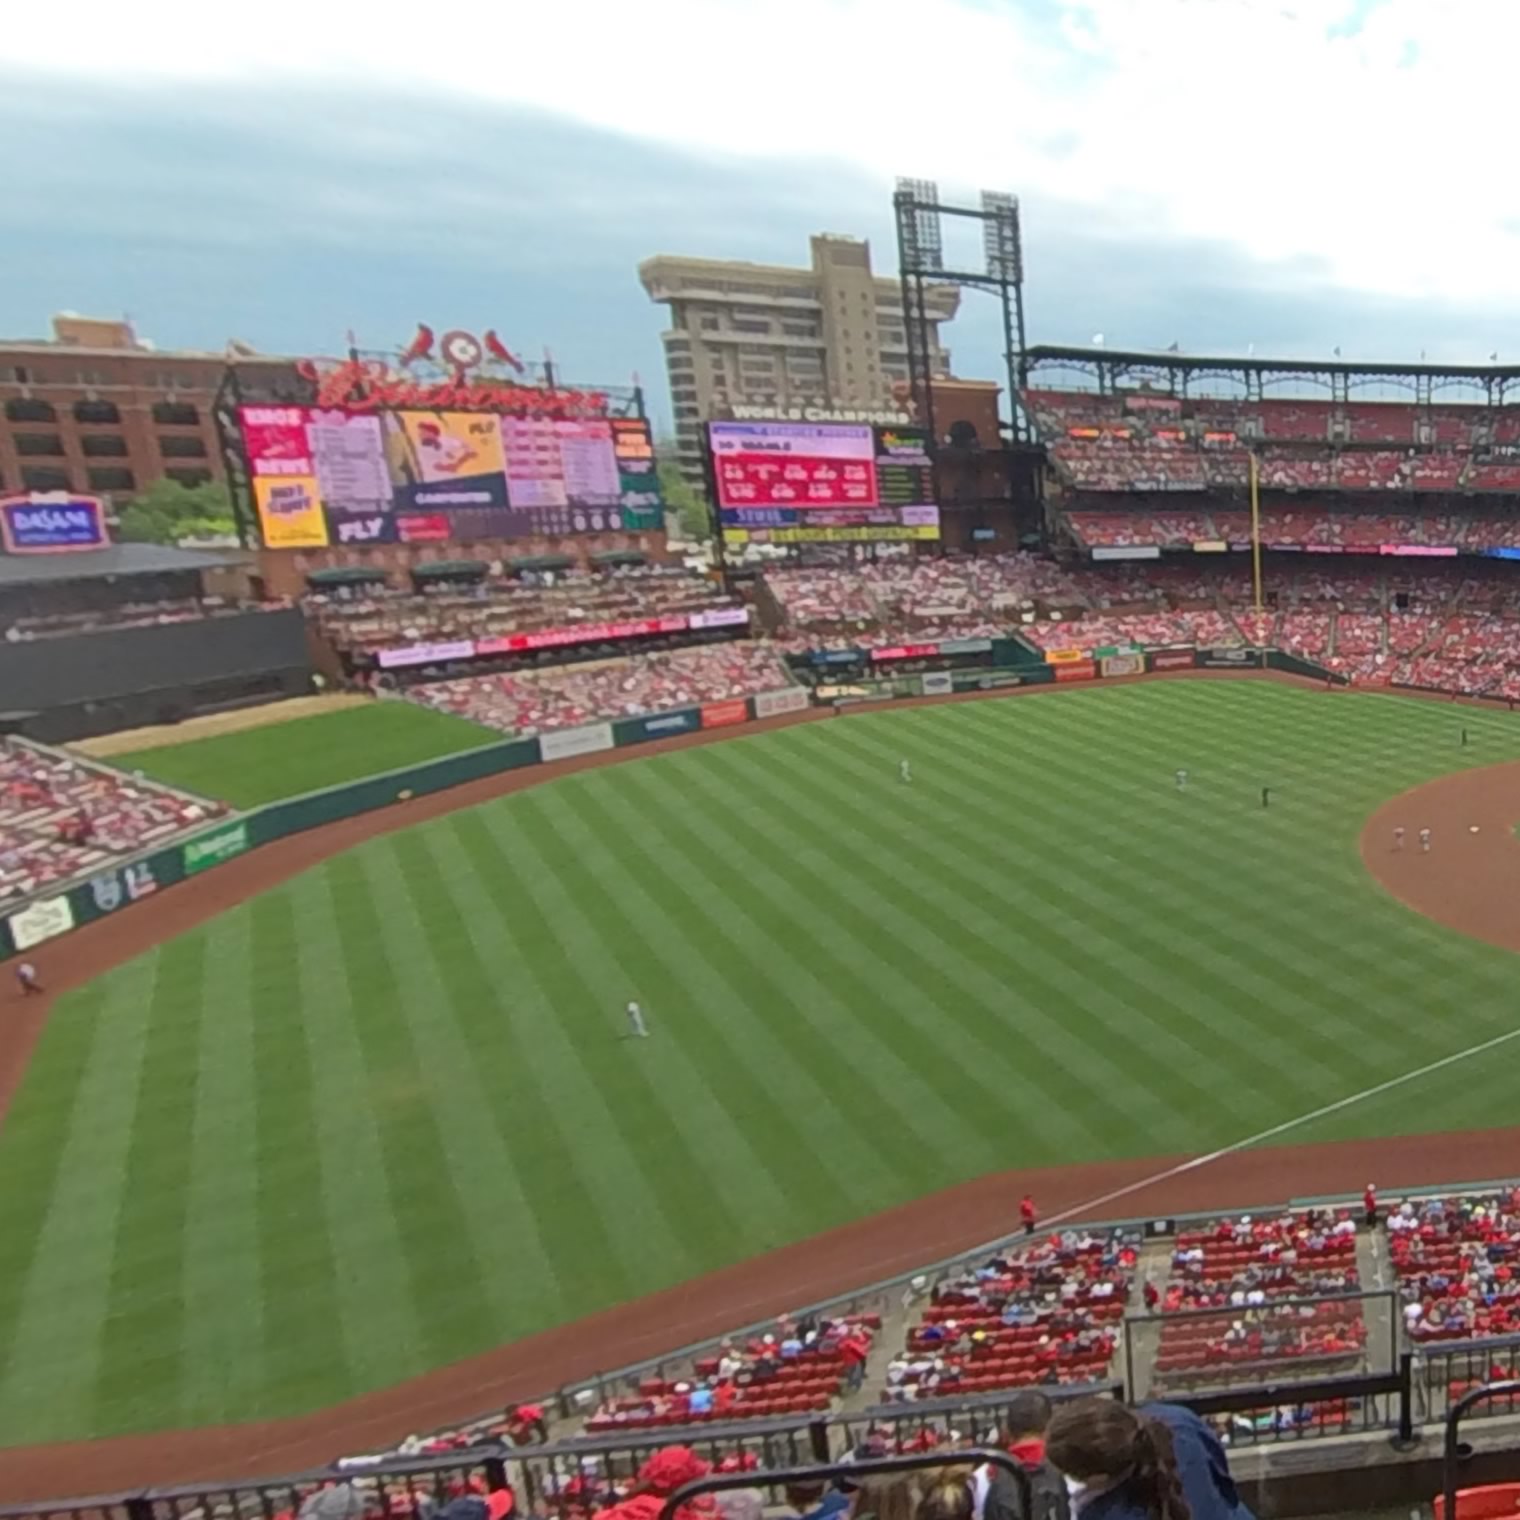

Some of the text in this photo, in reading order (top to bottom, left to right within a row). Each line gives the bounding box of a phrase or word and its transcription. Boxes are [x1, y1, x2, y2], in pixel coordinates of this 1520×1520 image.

[732, 405, 910, 424] WORLD CHAMPIONS
[14, 509, 90, 530] DASANI
[338, 517, 384, 541] FLY
